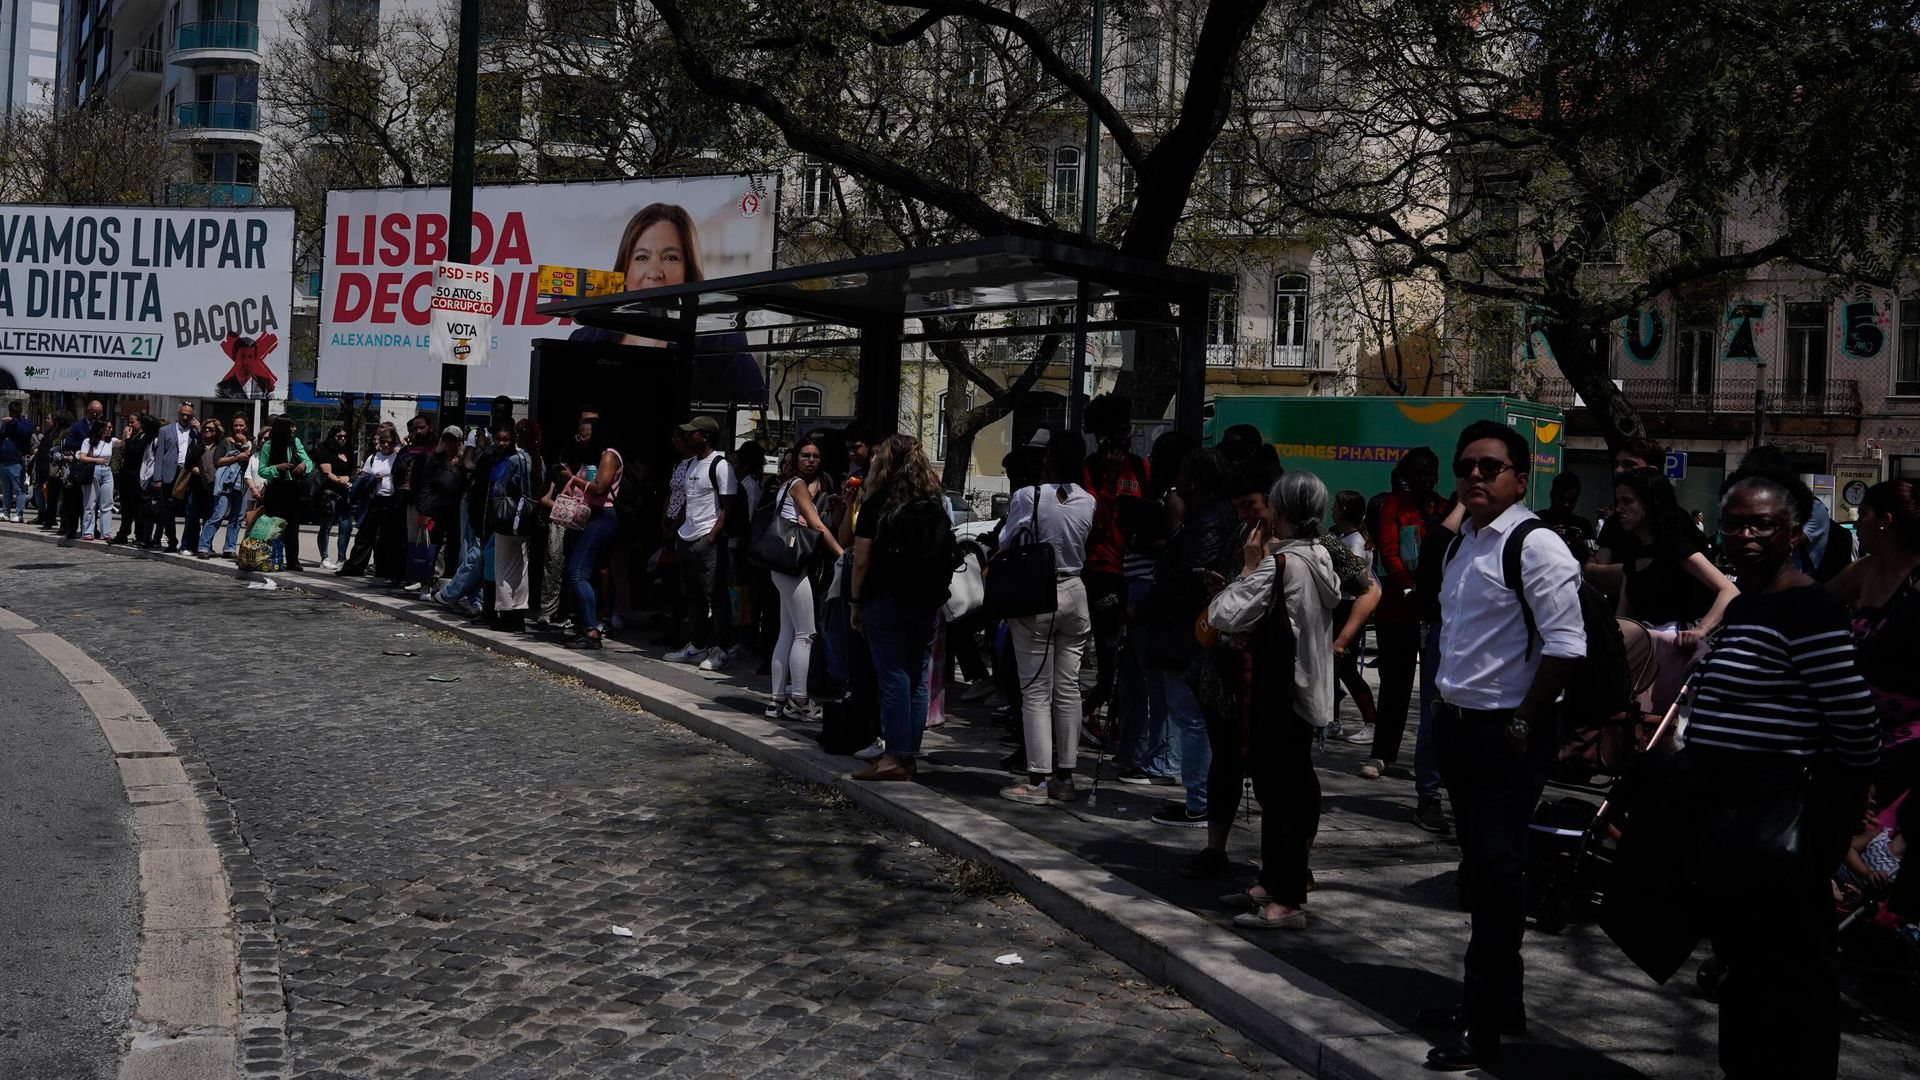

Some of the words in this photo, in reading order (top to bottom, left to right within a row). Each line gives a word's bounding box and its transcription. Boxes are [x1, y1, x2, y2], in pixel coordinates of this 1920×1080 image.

[0, 214, 121, 266] VAMOS
[131, 217, 268, 269] LIMPAR
[439, 266, 464, 280] PSD
[475, 271, 489, 283] PS
[26, 269, 163, 322] DIREITA
[436, 286, 451, 297] 50
[452, 287, 482, 301] ANOS
[173, 295, 279, 349] BACOCA
[447, 322, 478, 337] VOTA
[0, 331, 126, 355] LTERNATIVA
[131, 337, 153, 356] 21
[331, 333, 411, 347] ALEXANDRA
[35, 367, 50, 376] MPT
[93, 369, 151, 380] #alternativa21
[1664, 455, 1678, 476] P
